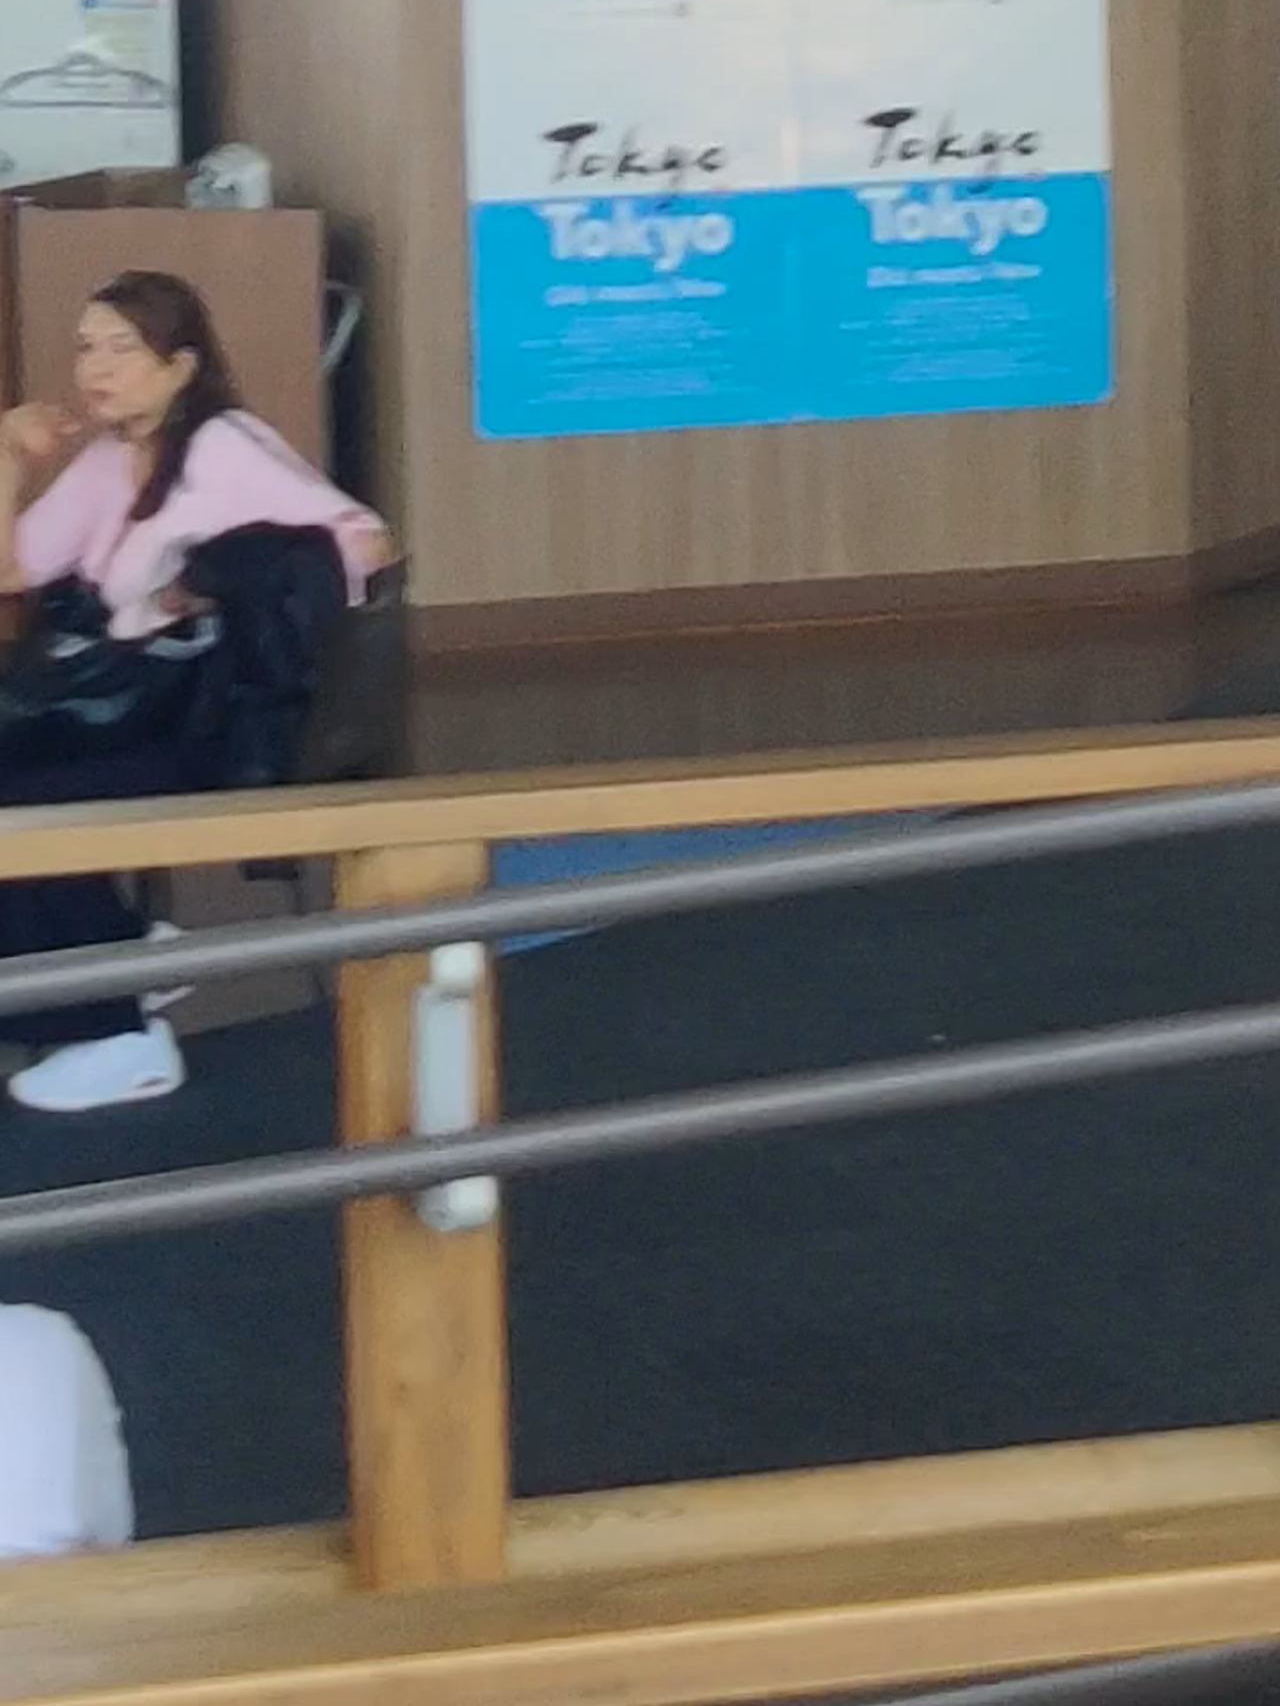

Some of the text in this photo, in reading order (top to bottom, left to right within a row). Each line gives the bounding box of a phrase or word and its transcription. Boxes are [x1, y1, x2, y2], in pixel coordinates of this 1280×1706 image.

[542, 121, 726, 208] Tokyo
[863, 107, 1040, 194] Tokyo
[536, 199, 733, 273] Tokyo
[856, 183, 1048, 256] Tokyo
